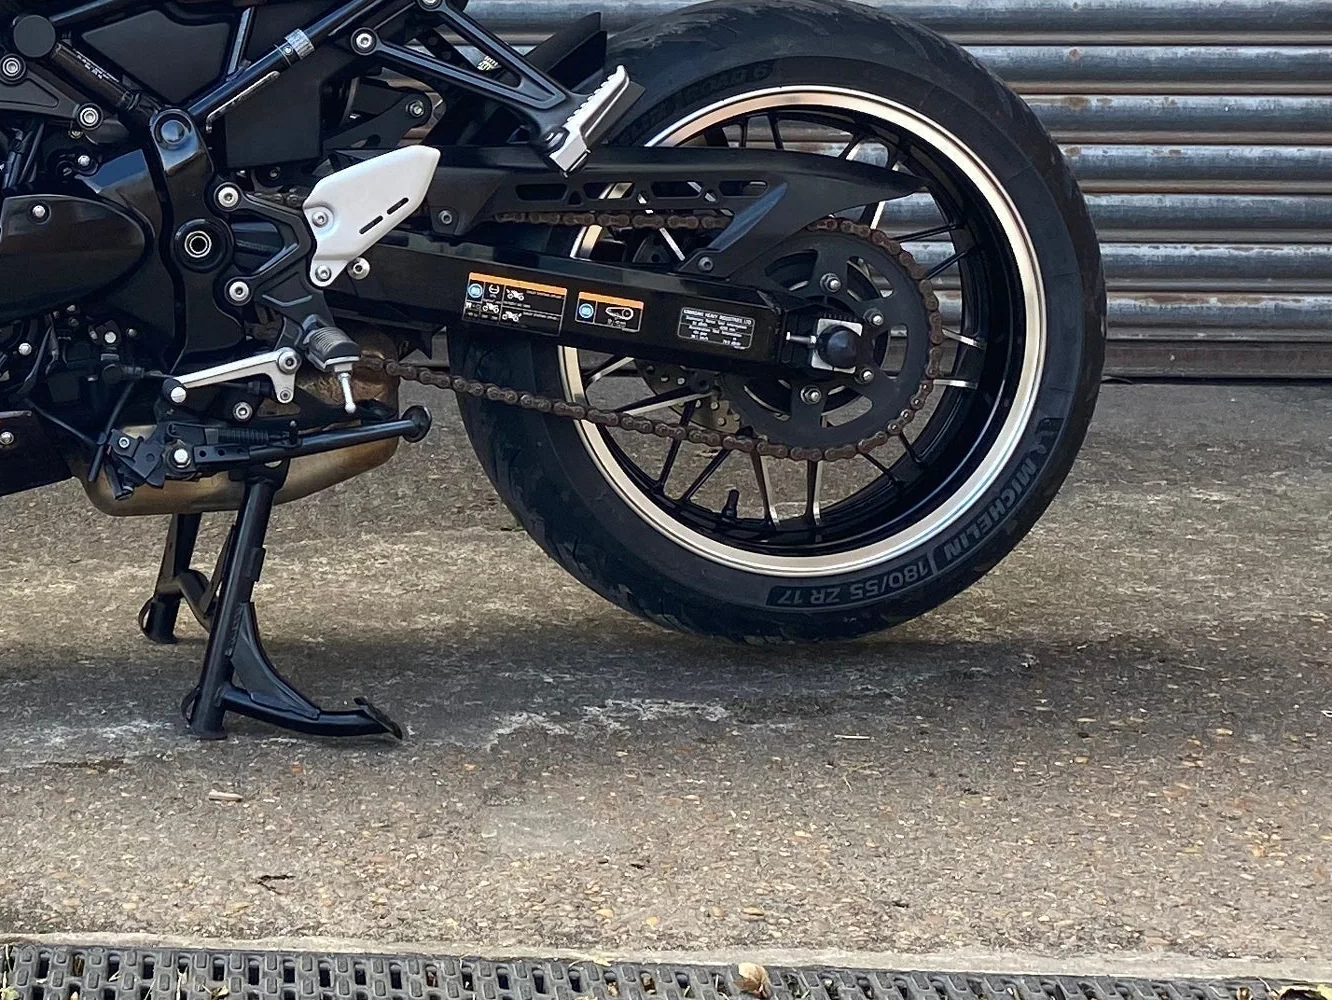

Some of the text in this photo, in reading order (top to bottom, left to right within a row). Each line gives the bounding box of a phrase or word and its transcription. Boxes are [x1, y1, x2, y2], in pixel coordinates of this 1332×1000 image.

[777, 458, 1037, 605] MICHELIN 180/55 ZR 17
